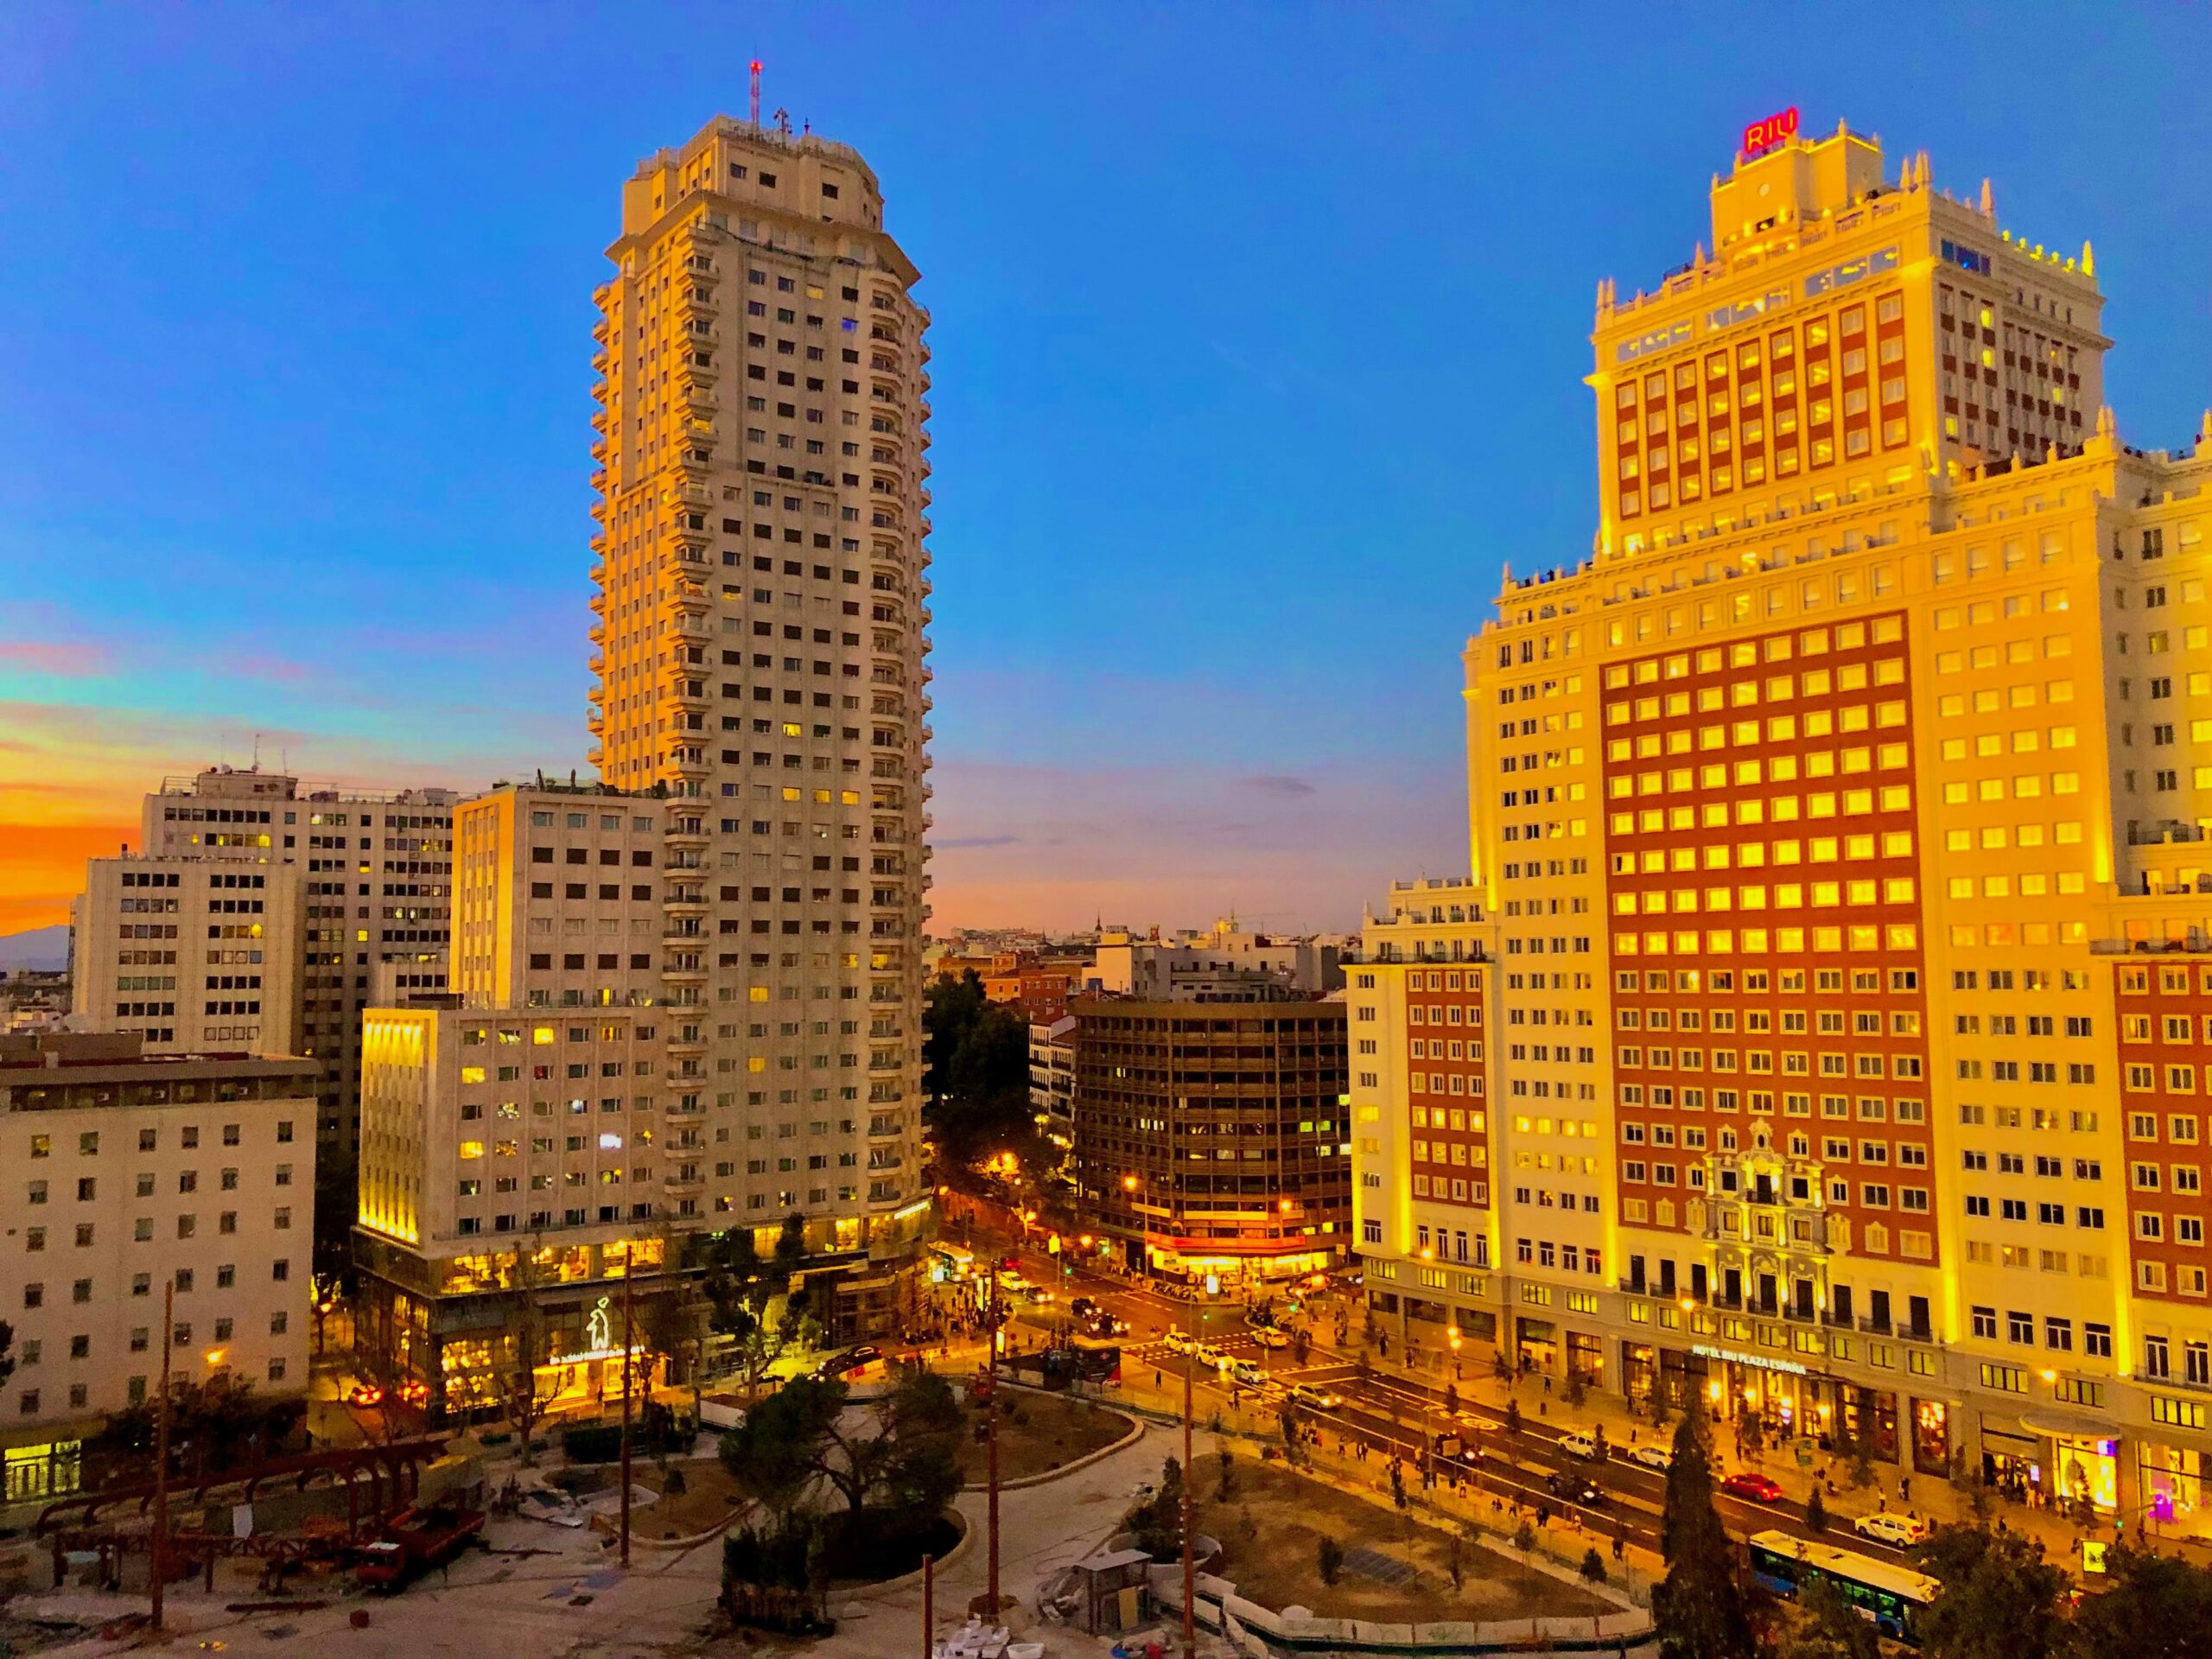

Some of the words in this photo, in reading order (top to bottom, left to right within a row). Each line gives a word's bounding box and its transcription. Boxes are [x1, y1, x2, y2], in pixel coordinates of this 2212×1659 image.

[1745, 108, 1797, 153] RIU
[1692, 1344, 1720, 1359] HOTEL
[1721, 1350, 1738, 1362] RIU
[1738, 1353, 1769, 1369] PLAZA
